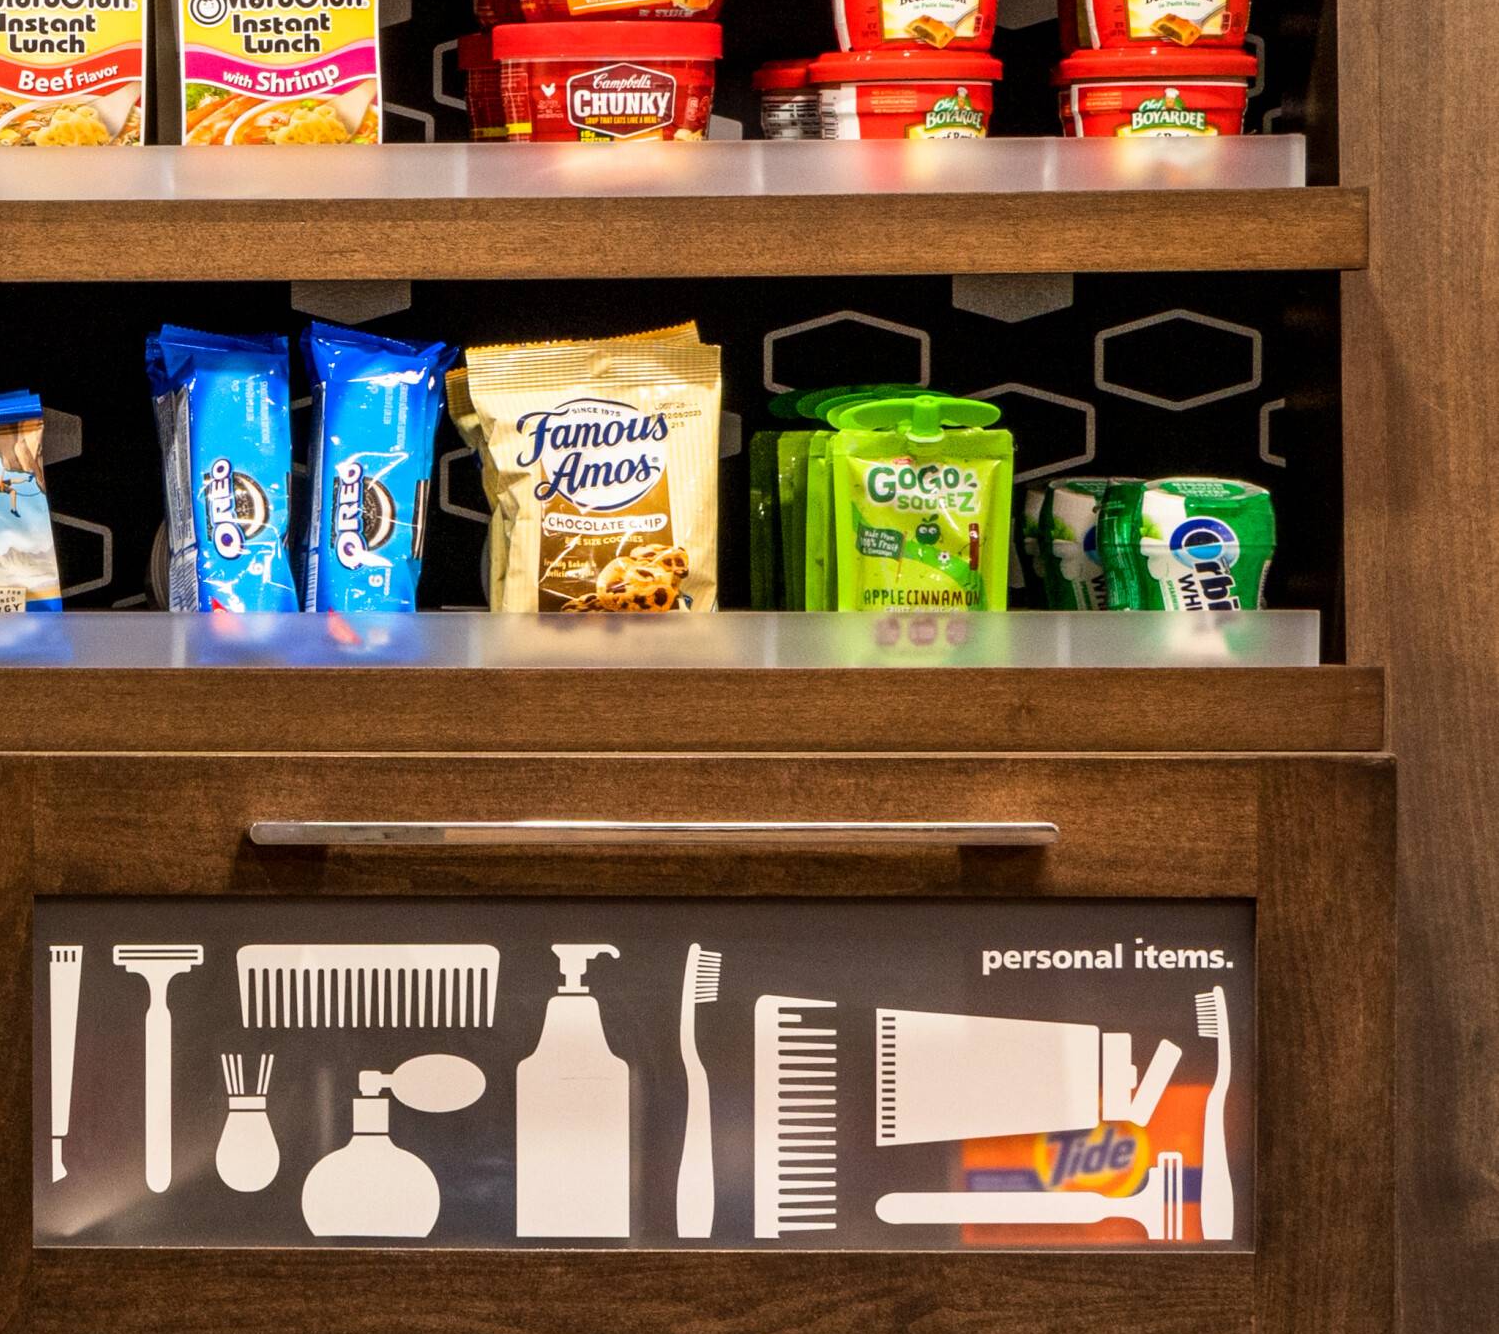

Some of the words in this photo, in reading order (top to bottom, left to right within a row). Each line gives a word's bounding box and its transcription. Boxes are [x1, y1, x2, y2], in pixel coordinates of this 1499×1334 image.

[19, 69, 75, 92] Beef
[76, 63, 119, 85] Flavor
[223, 71, 254, 88] with
[255, 65, 340, 94] Shrimp
[573, 90, 670, 117] CHUNKY
[572, 406, 597, 414] SINCE
[516, 412, 668, 467] Famous
[534, 452, 661, 501] Amos
[213, 459, 245, 560] OREO
[548, 518, 624, 530] CHOCOLATE
[982, 943, 1123, 975] personal
[1134, 938, 1234, 968] items.
[1044, 1128, 1136, 1188] Tide
